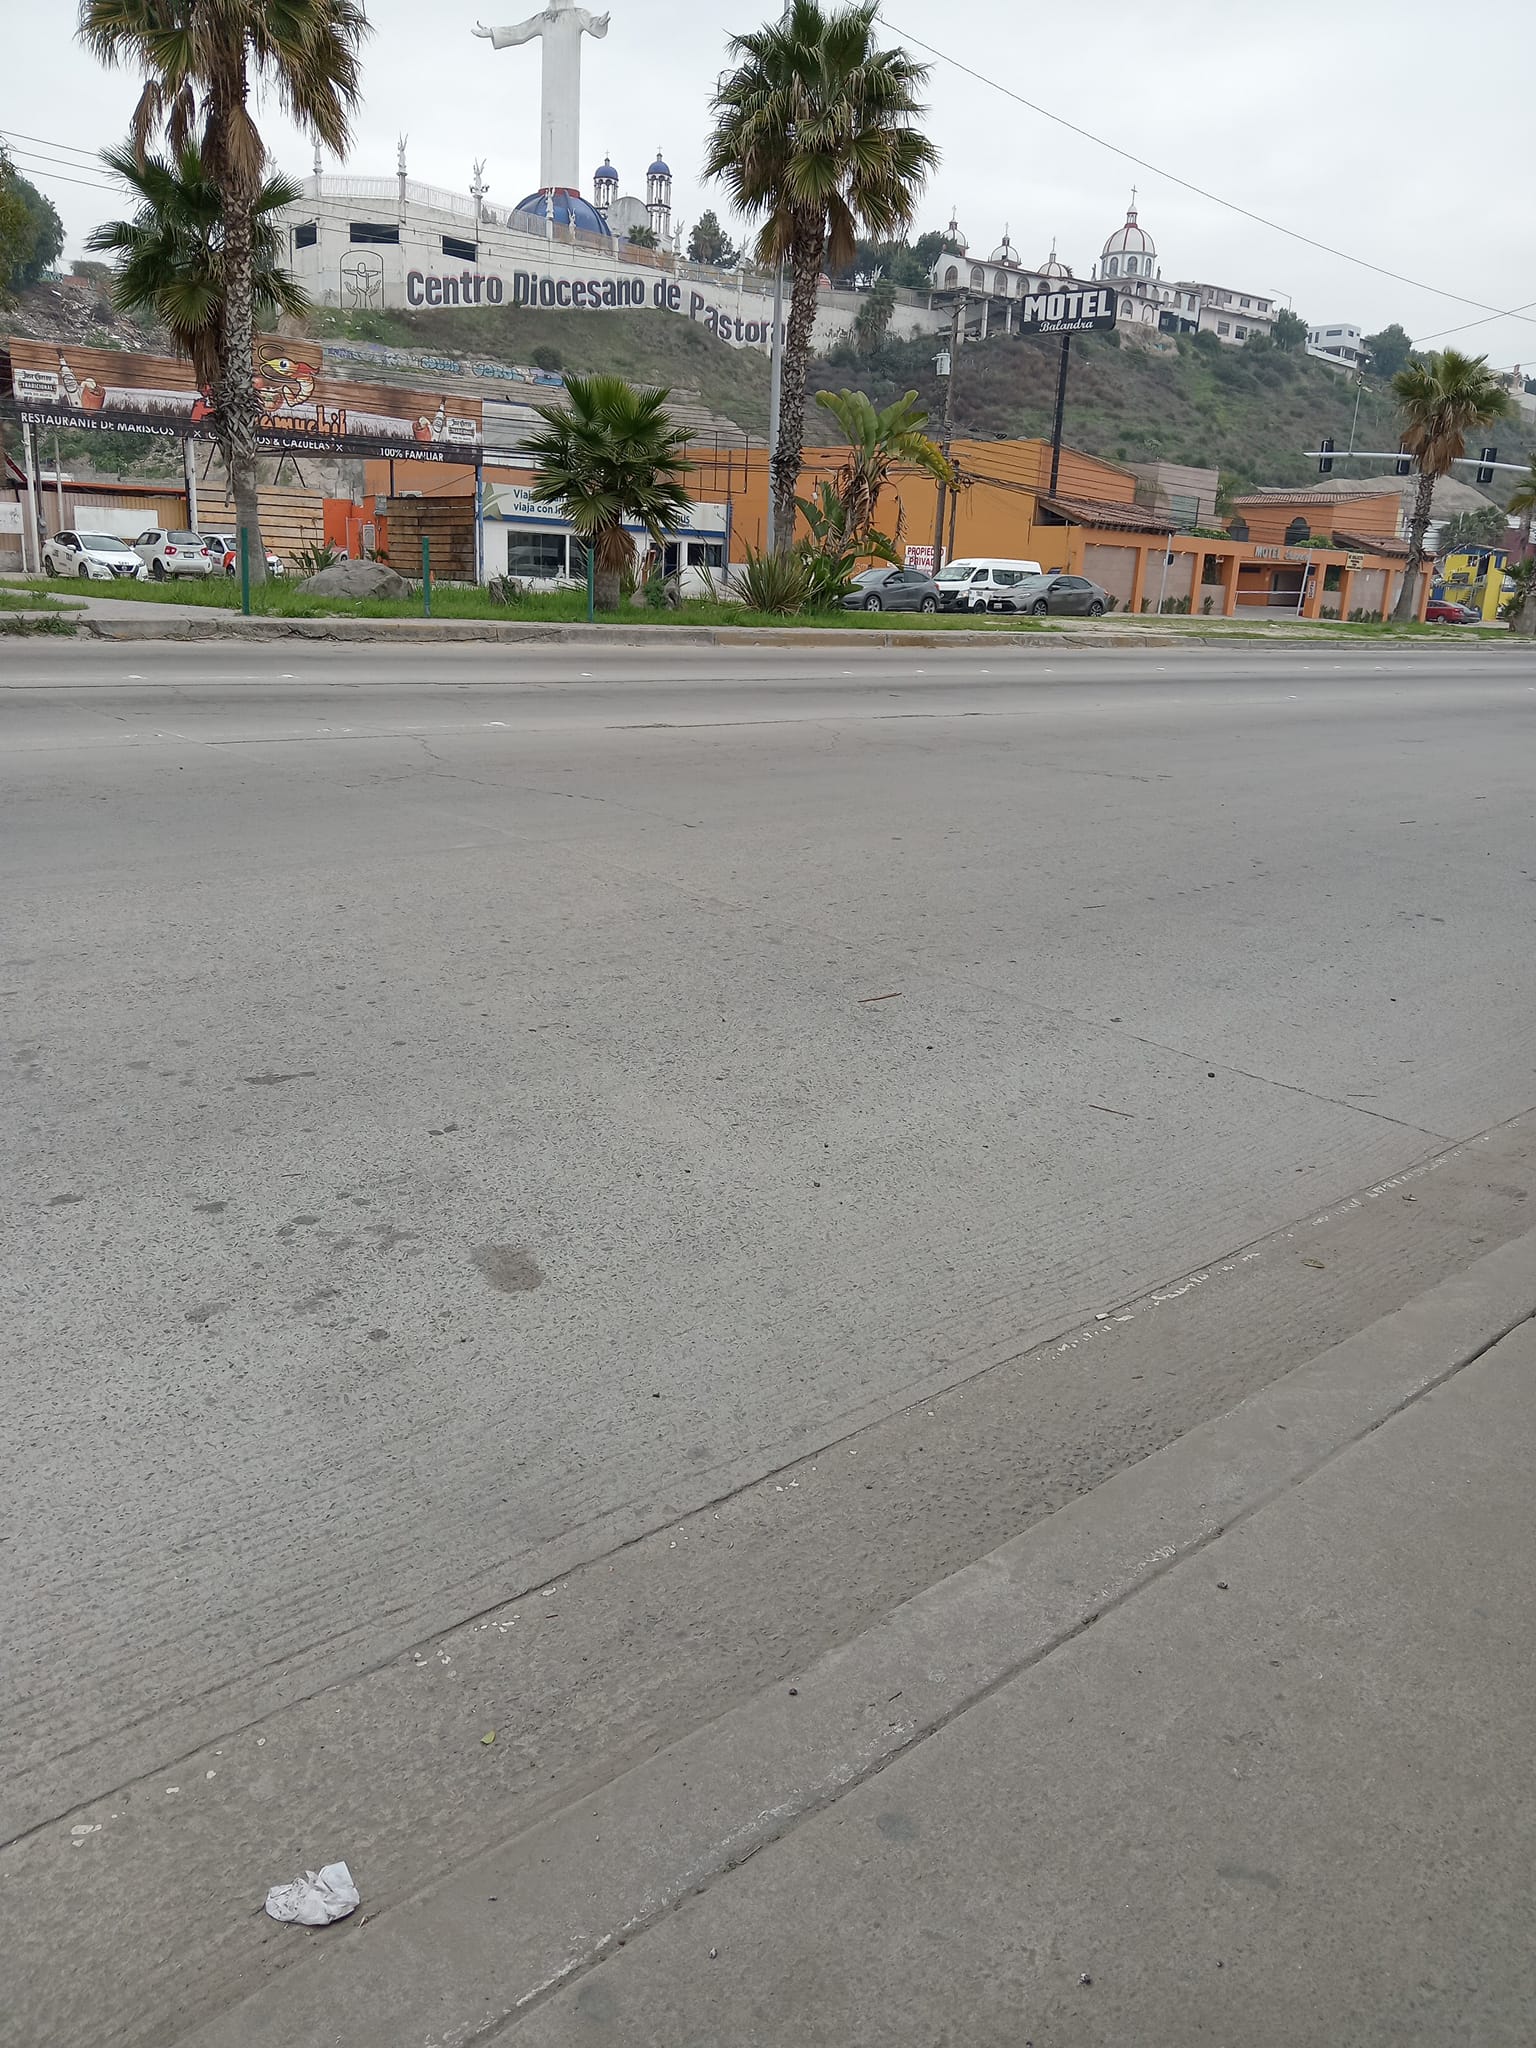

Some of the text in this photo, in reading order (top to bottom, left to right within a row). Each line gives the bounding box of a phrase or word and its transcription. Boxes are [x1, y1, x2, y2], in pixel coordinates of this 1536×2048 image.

[407, 270, 787, 345] Centro Diocesano de Pastora
[1024, 290, 1112, 322] MOTEL
[1039, 319, 1094, 332] Balandra
[21, 412, 175, 436] RESTAURANTE DE MARISCOS
[380, 447, 444, 461] 100% FAMILIAR
[513, 502, 535, 513] viaja
[536, 505, 553, 513] con
[907, 546, 945, 557] PROPIEDD
[1255, 546, 1280, 559] MOTEL
